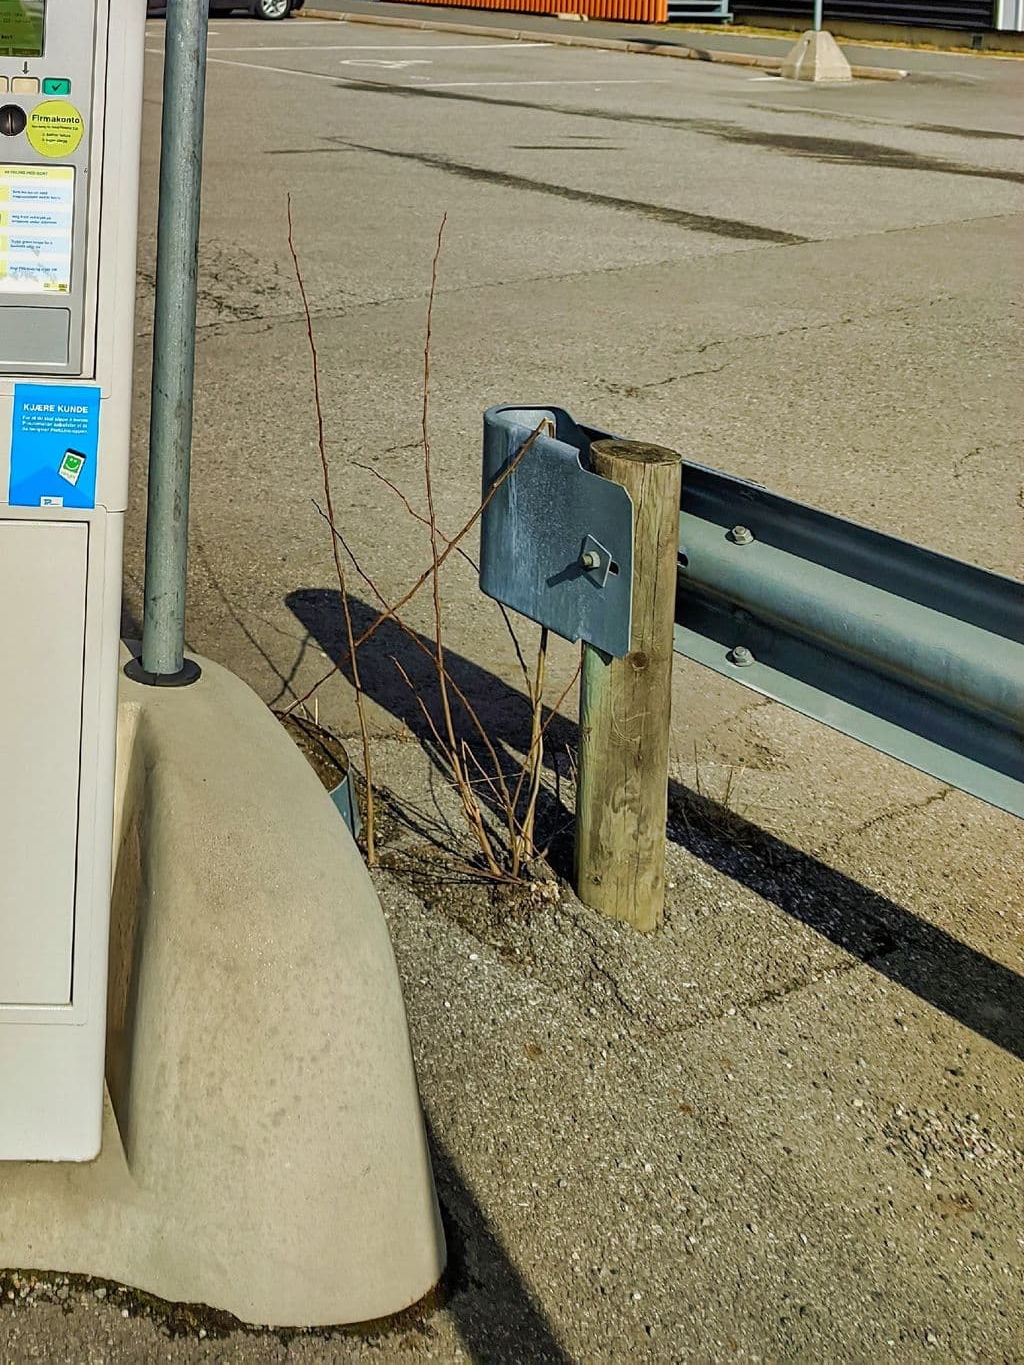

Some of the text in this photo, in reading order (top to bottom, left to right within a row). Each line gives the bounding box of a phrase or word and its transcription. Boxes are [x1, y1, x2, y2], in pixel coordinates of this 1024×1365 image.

[32, 114, 80, 124] Firmakonto
[23, 403, 89, 414] KJÆRE KUNDE
